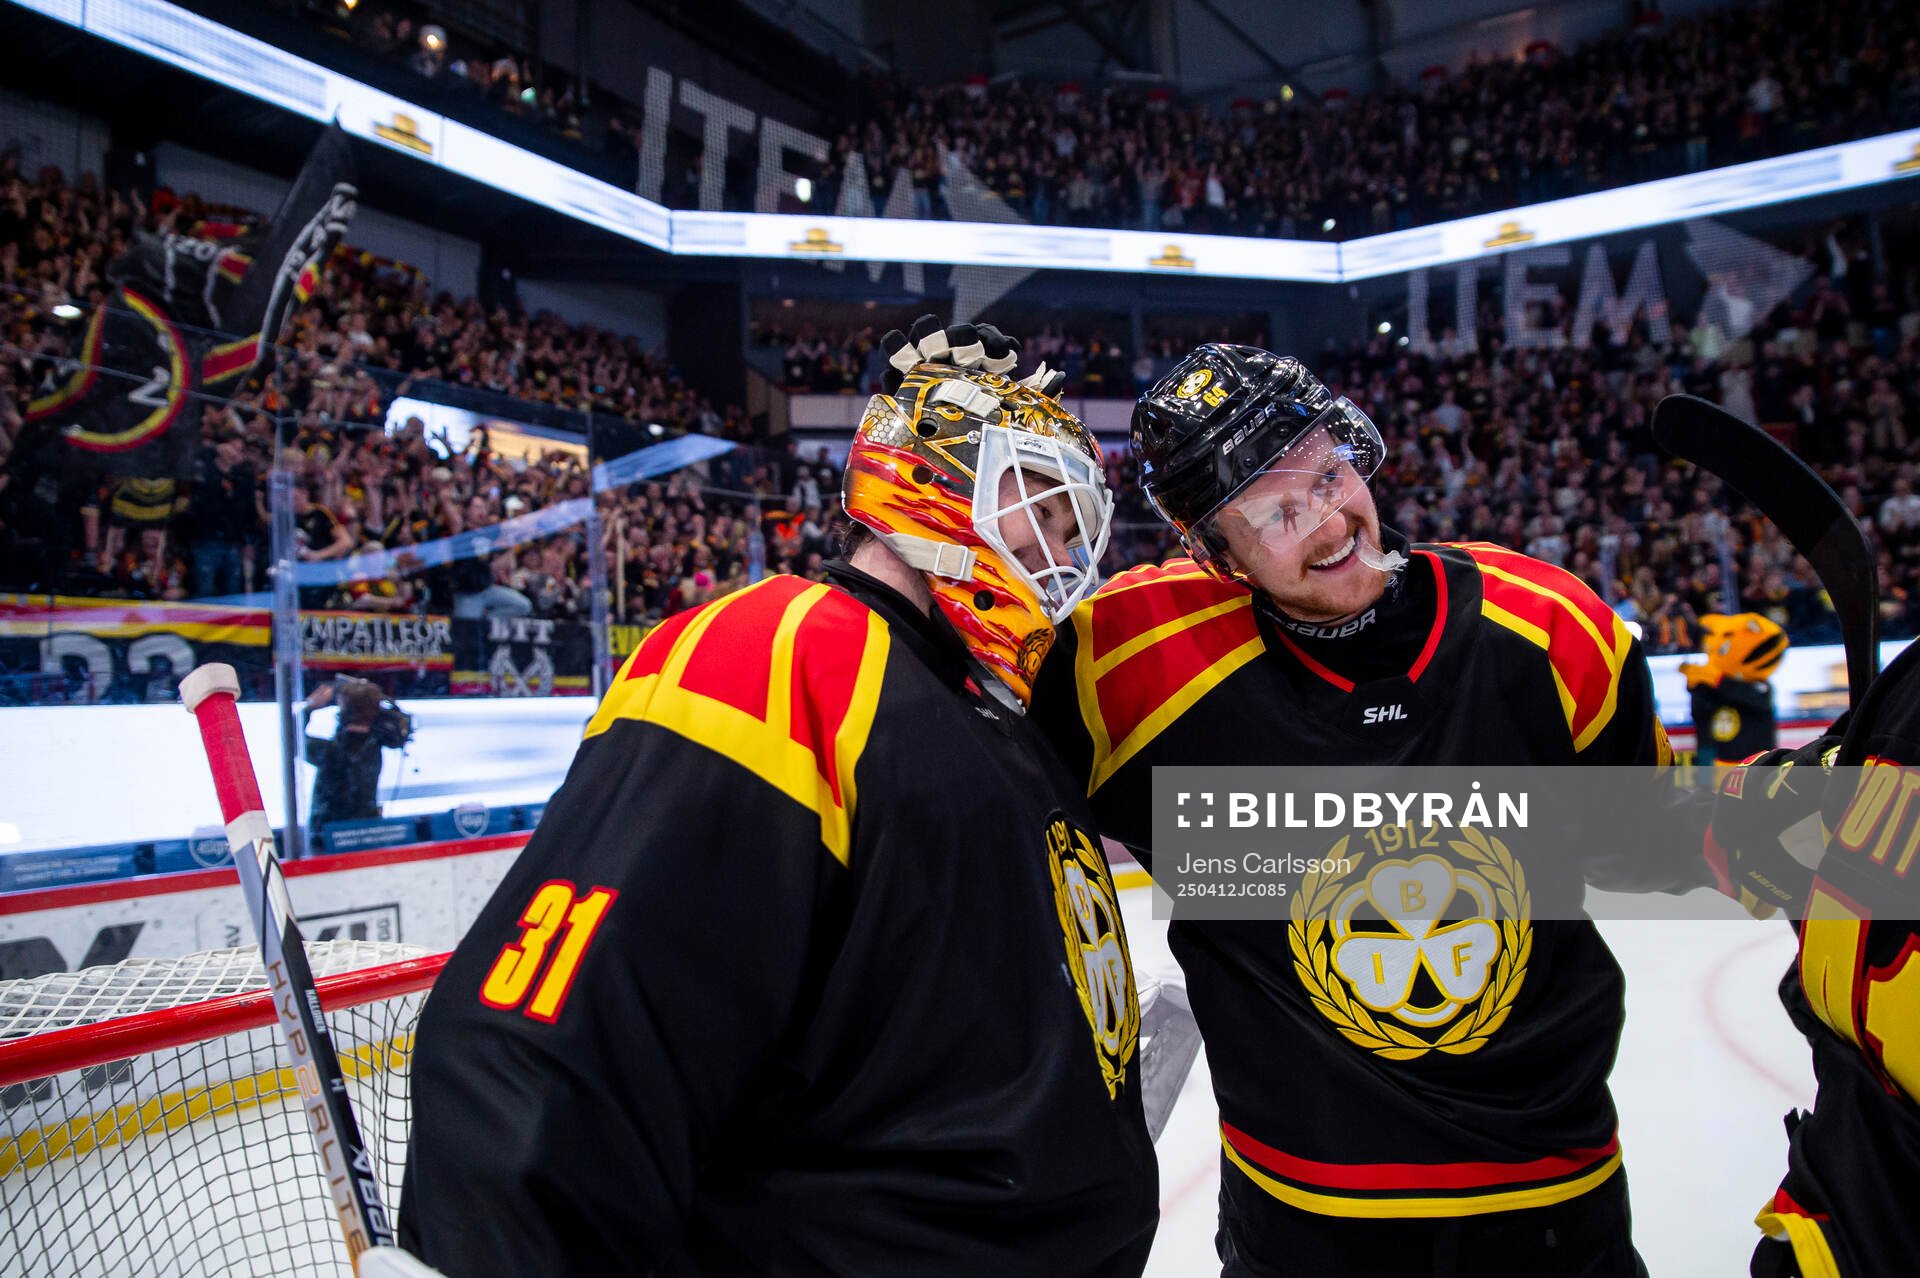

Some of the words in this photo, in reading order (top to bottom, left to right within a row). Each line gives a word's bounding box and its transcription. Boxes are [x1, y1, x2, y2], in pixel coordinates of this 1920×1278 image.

[1202, 386, 1229, 408] 64
[1221, 401, 1278, 456] BAUER
[1362, 704, 1408, 725] SHL
[1364, 820, 1441, 857] 1912
[480, 880, 617, 1024] 31
